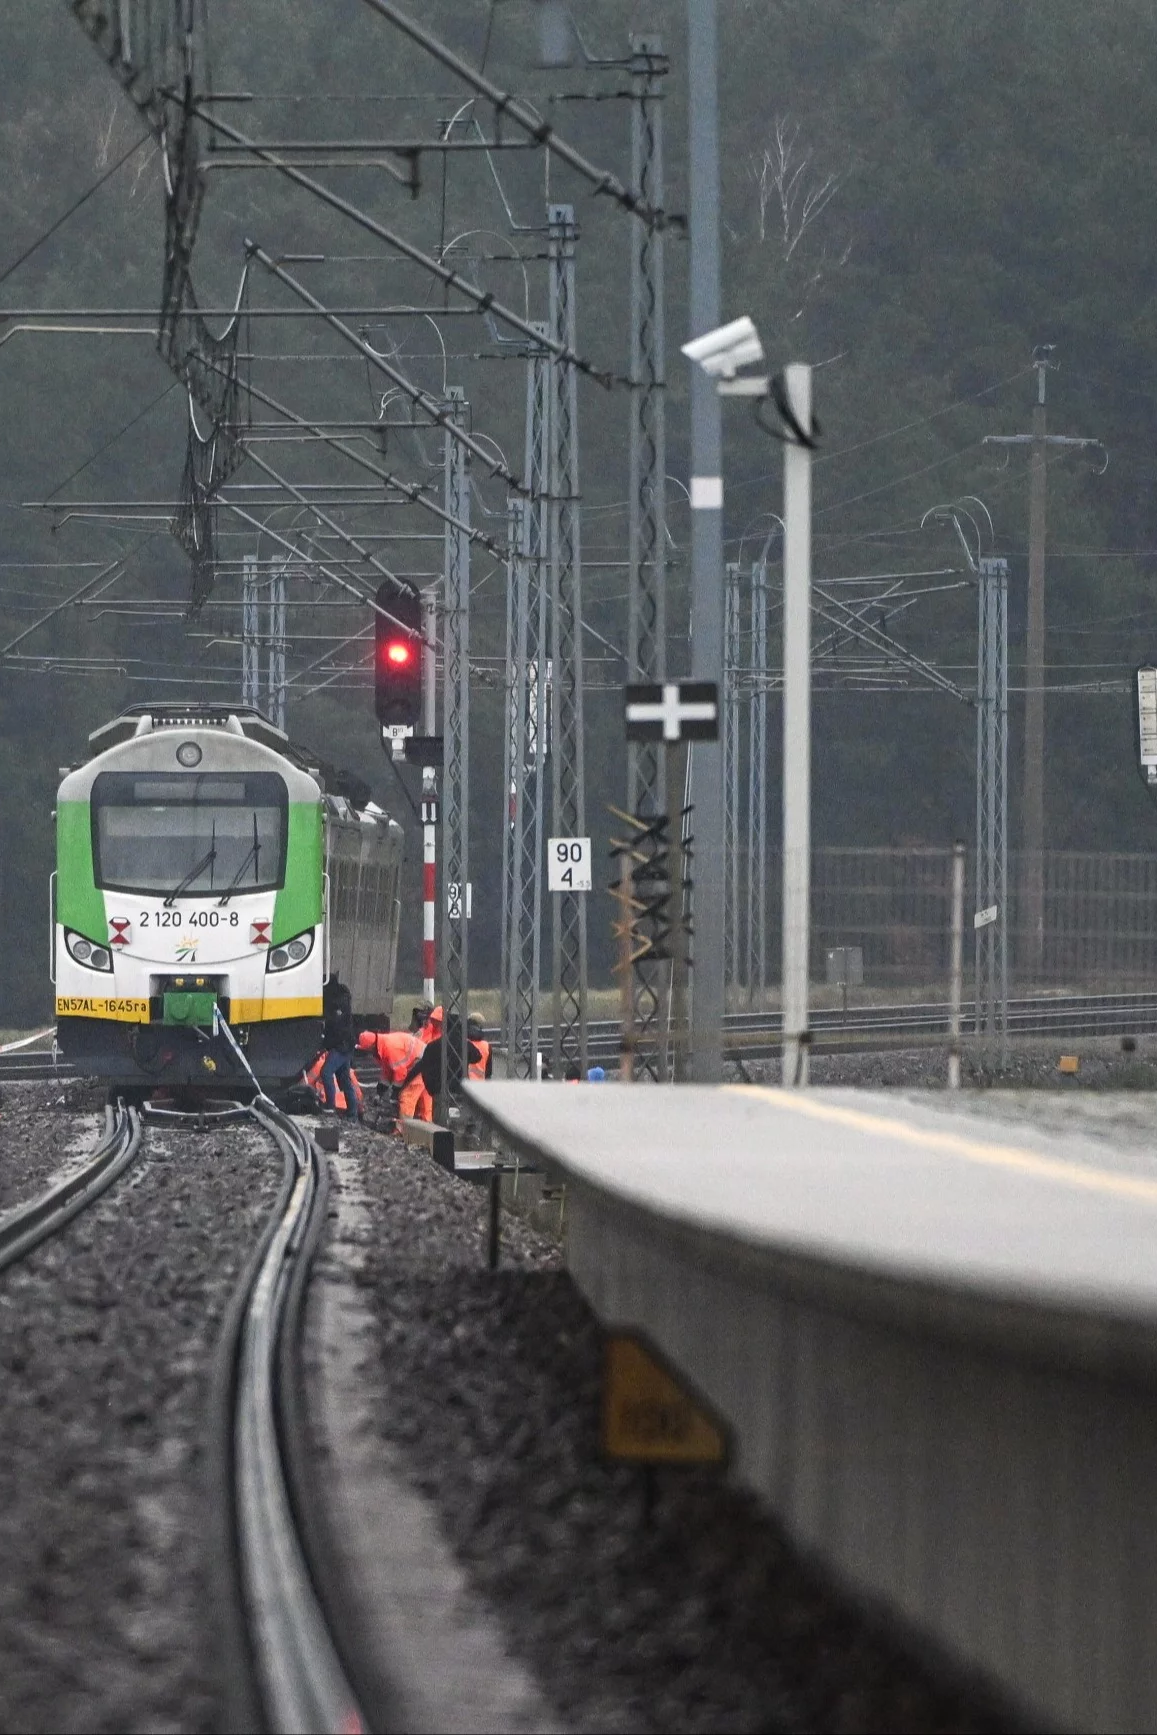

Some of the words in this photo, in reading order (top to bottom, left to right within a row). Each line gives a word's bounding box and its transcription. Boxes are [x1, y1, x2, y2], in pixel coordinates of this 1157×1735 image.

[556, 842, 582, 863] 90
[560, 867, 573, 888] 4
[139, 911, 150, 928] 2
[154, 911, 182, 928] 120
[188, 911, 240, 928] 400-8
